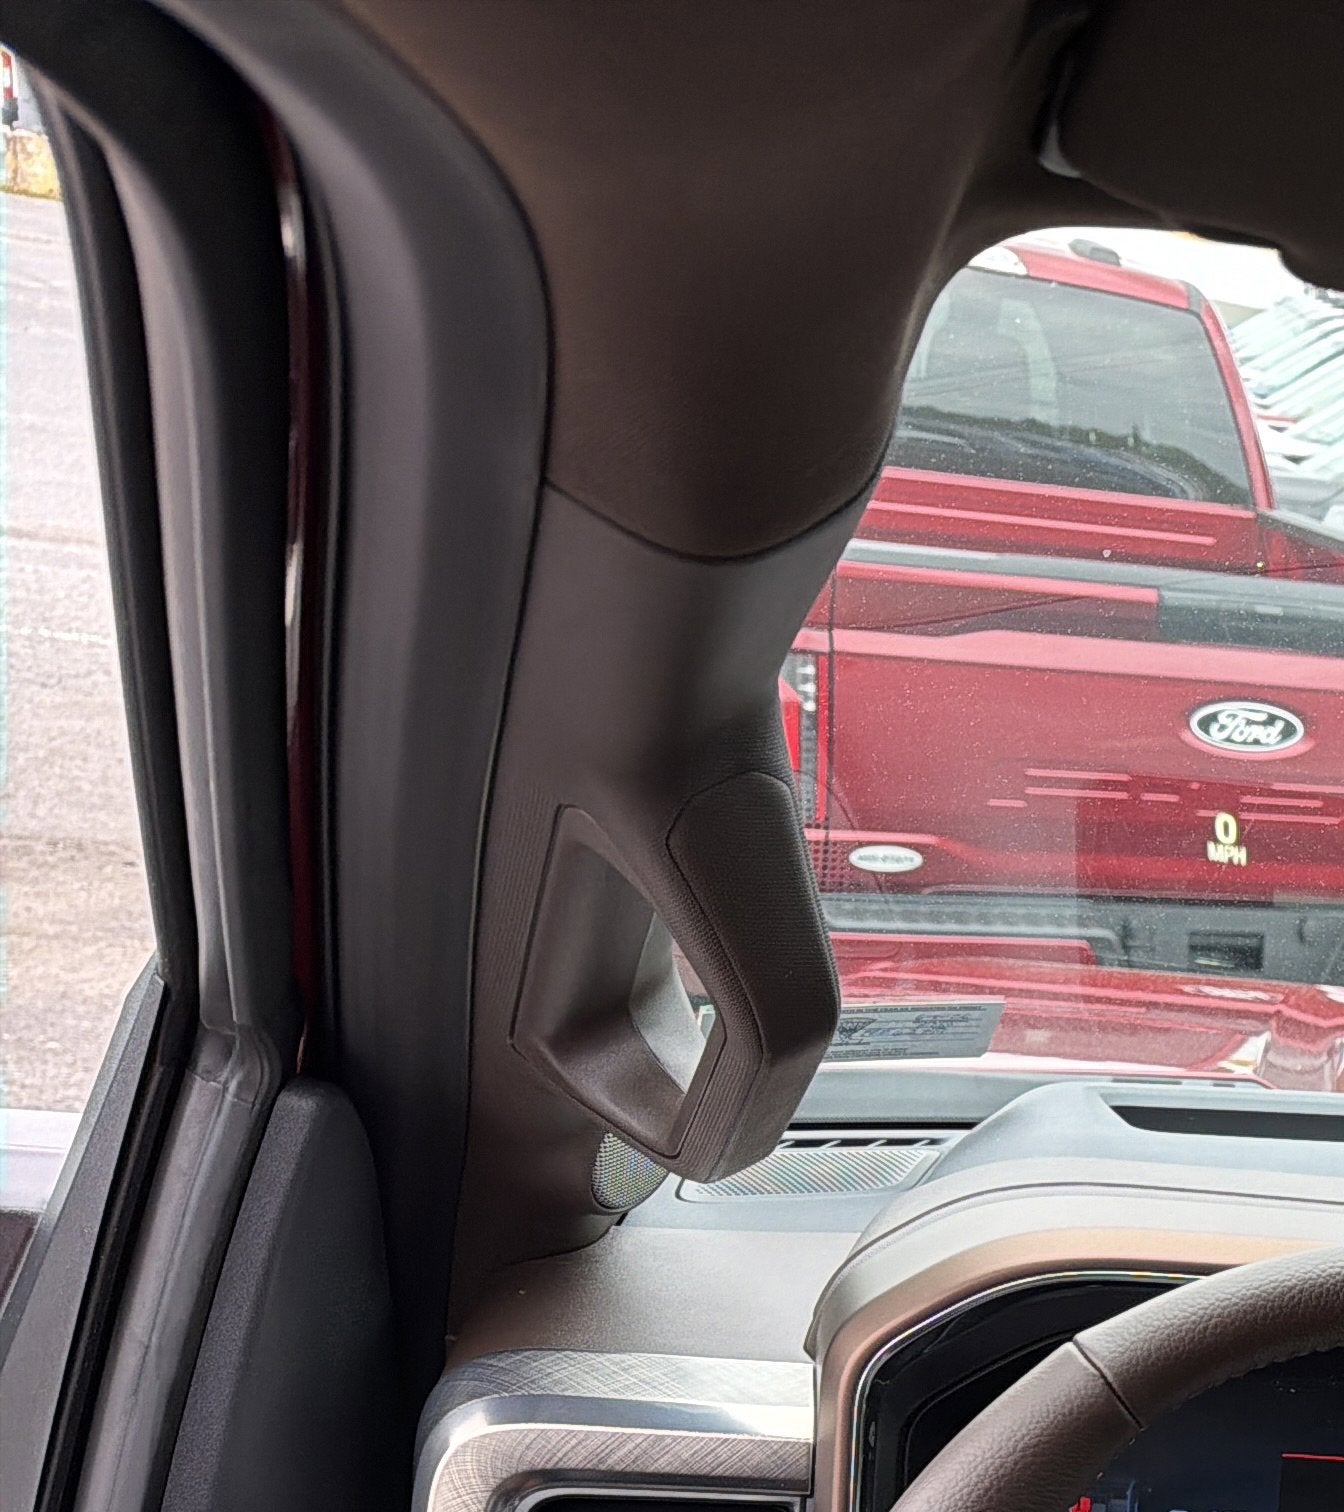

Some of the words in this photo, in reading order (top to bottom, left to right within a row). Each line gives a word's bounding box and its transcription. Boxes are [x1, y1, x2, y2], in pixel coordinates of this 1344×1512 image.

[1209, 708, 1282, 745] Ford
[1215, 812, 1238, 845] 0
[1207, 842, 1247, 867] MPH
